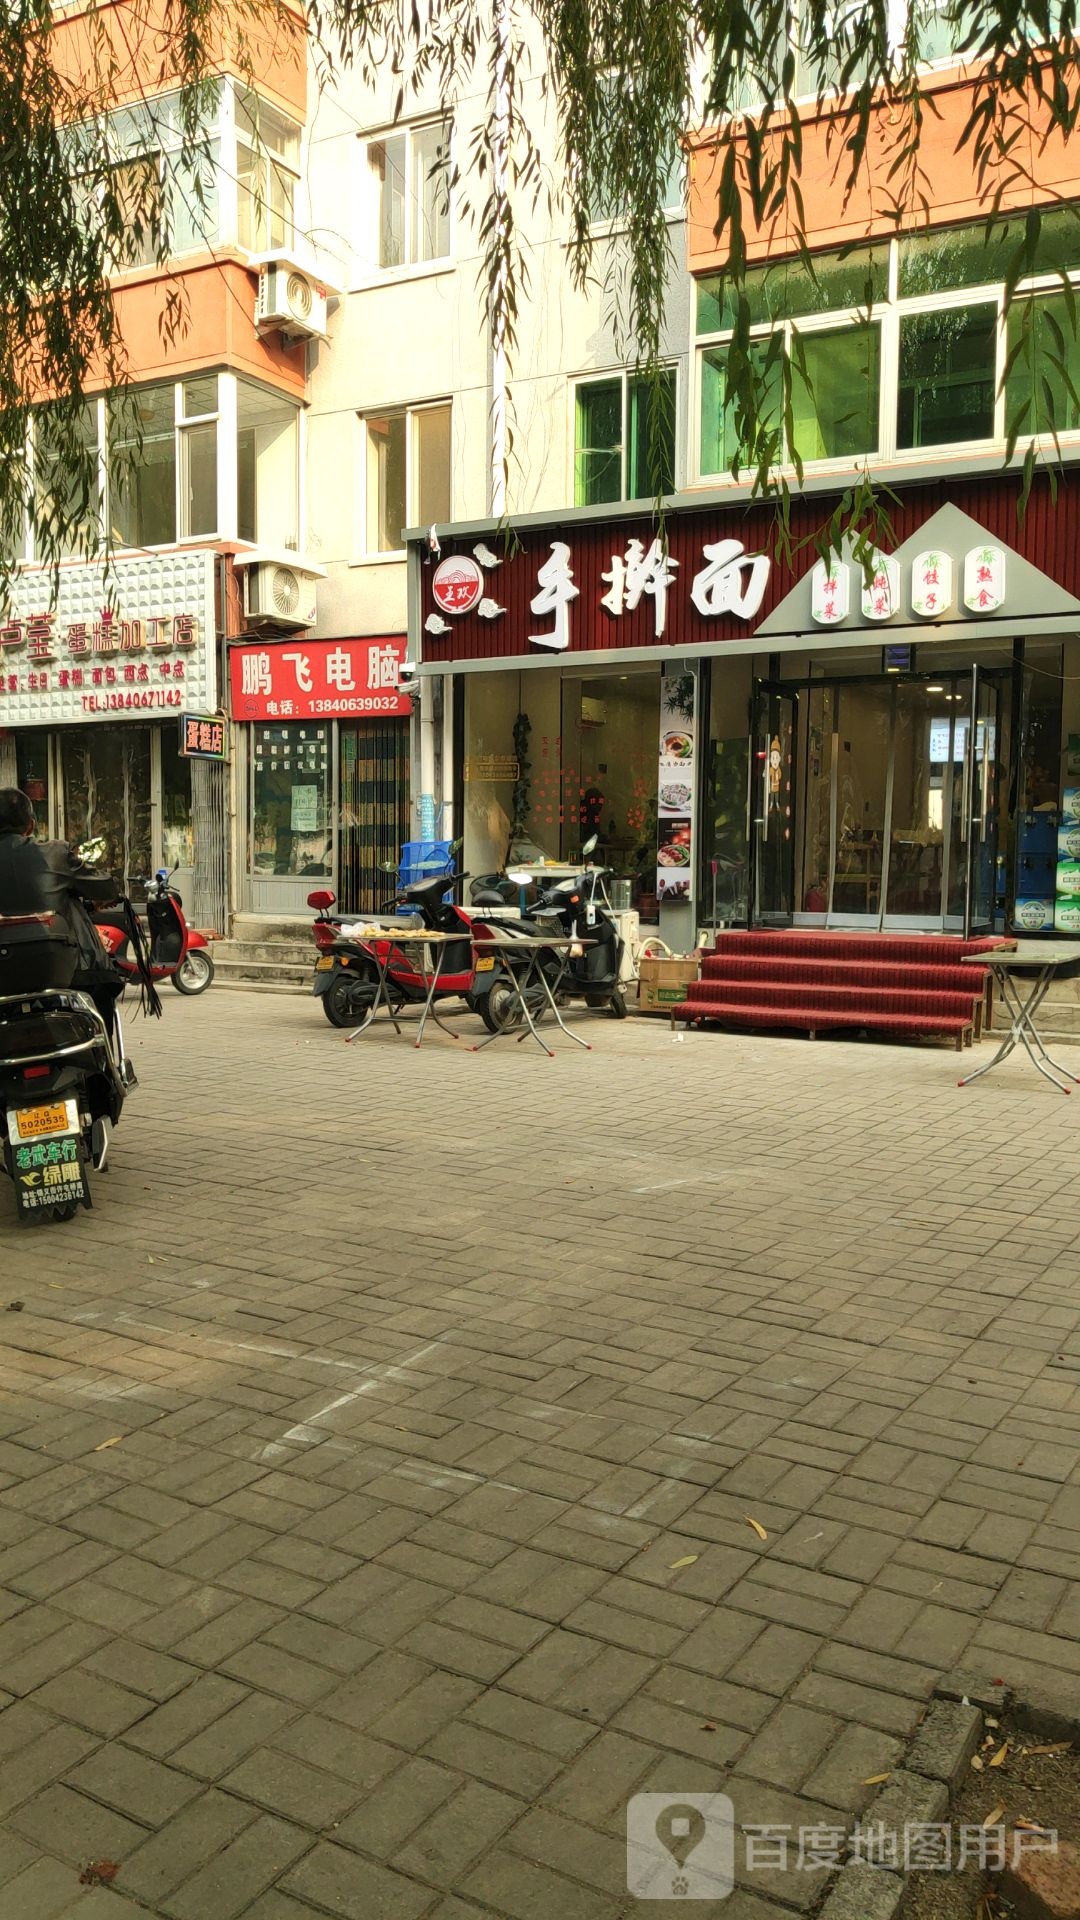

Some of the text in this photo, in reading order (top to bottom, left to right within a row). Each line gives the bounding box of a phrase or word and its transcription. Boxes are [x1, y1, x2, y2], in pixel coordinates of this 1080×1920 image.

[528, 538, 770, 649] 手擀面
[923, 569, 939, 610] 饺子
[976, 566, 994, 607] 熟食
[67, 612, 195, 654] 蛋糕加工店
[241, 644, 400, 696] 鹏飞电脑
[308, 696, 399, 713] 13840639032
[187, 720, 223, 753] 蛋糕店
[16, 1139, 77, 1169] 老武车行
